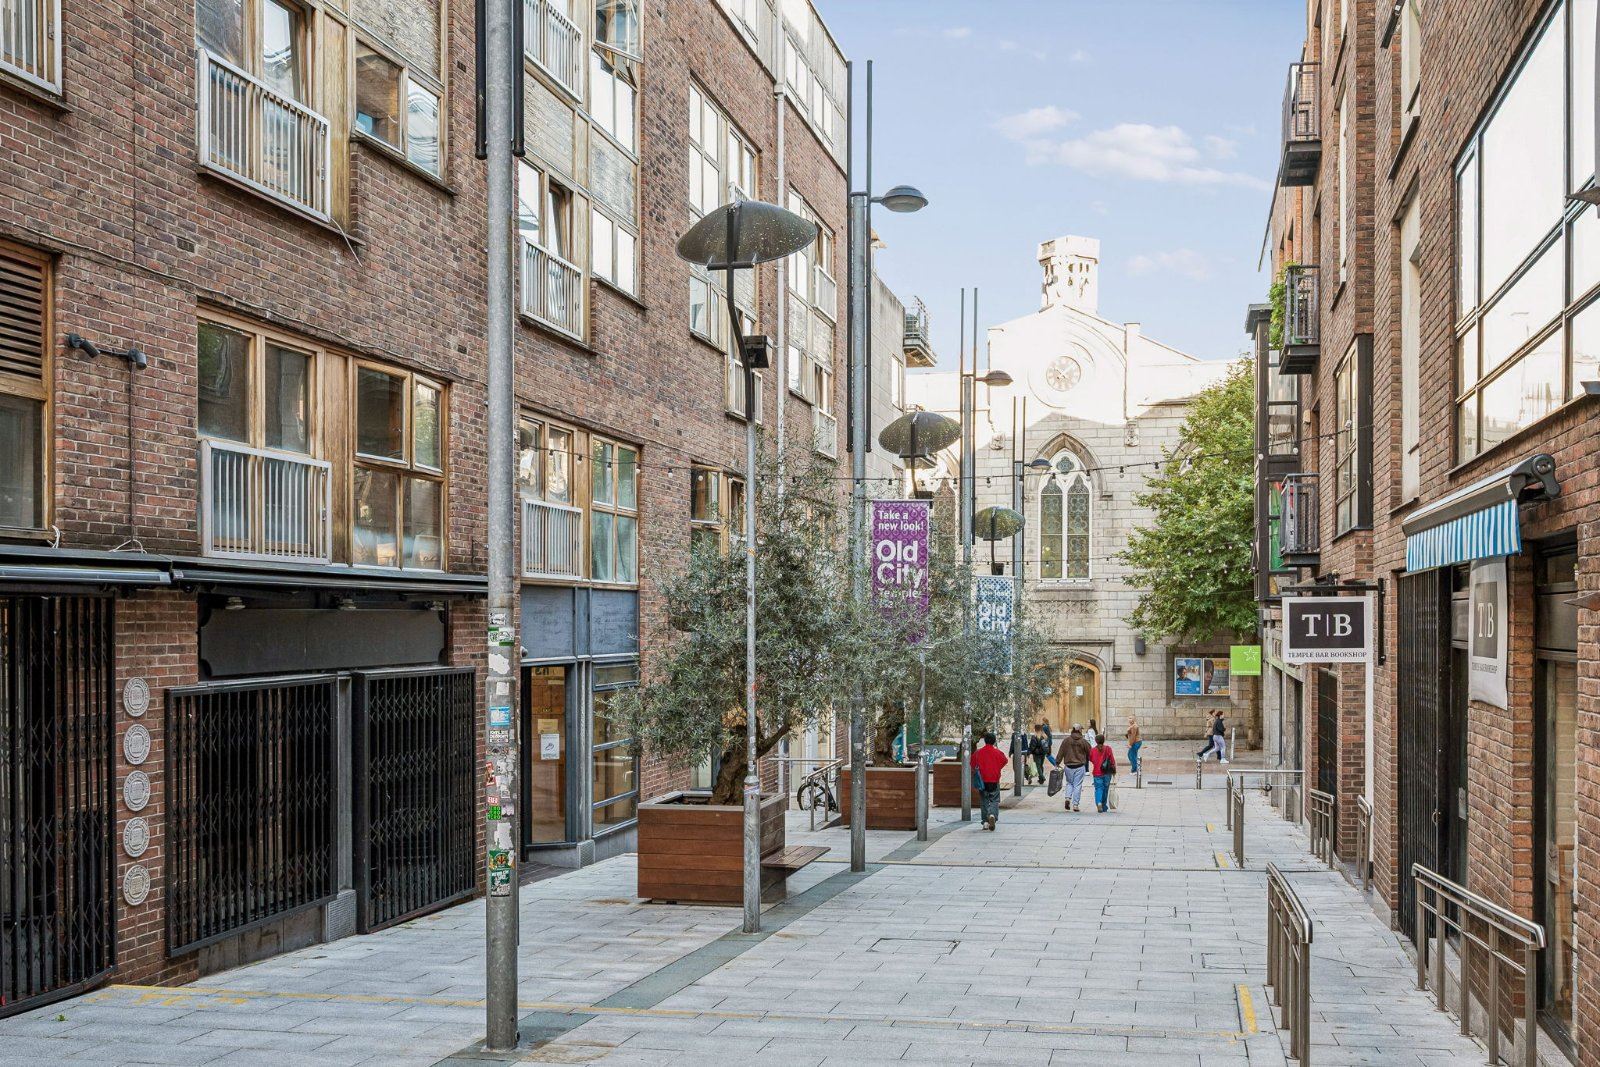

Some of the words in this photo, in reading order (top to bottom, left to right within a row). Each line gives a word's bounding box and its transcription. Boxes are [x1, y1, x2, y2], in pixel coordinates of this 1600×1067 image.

[878, 510, 900, 520] Take
[903, 512, 908, 520] a
[879, 522, 898, 530] new
[901, 521, 924, 531] look!
[876, 539, 918, 562] Old
[877, 562, 925, 588] City
[979, 601, 1007, 617] Old
